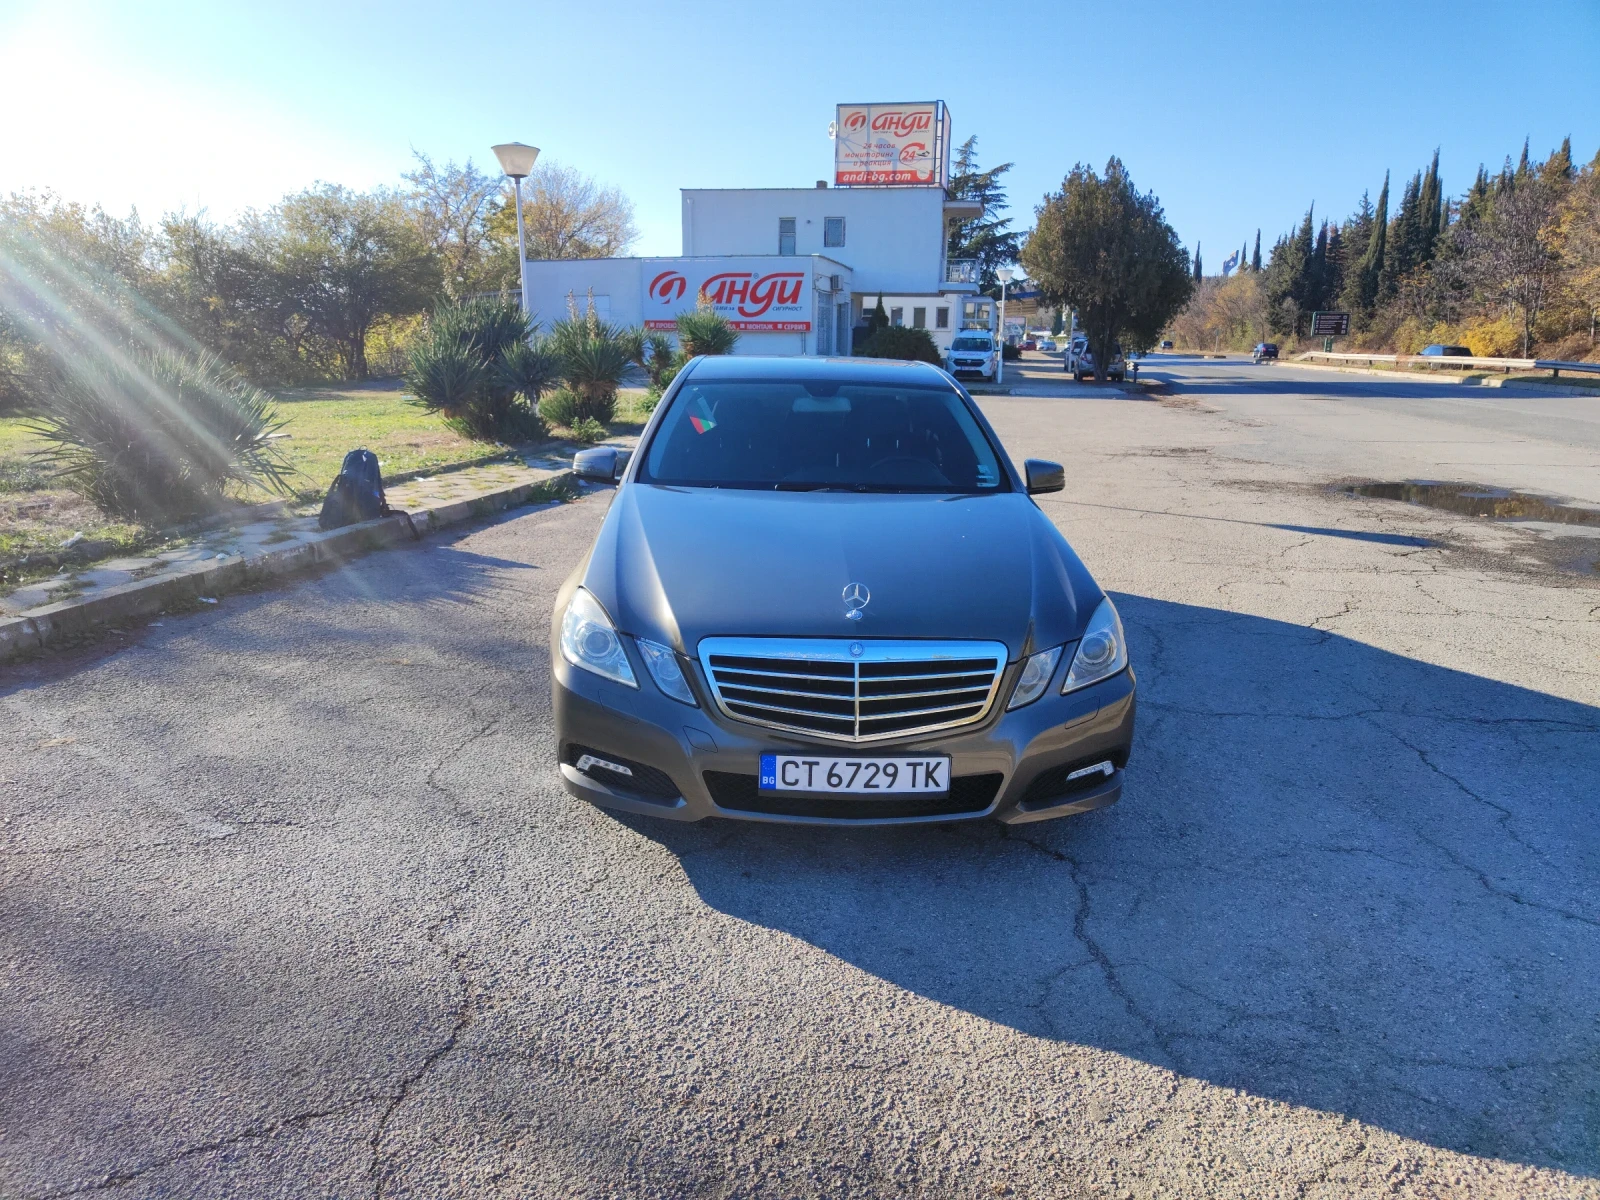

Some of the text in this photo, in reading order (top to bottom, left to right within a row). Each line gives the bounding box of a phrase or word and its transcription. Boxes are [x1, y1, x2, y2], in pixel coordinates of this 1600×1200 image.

[901, 150, 916, 161] 24
[843, 171, 911, 182] andi-bg.com
[781, 760, 943, 789] CT 6729 TK
[762, 776, 775, 785] BG
